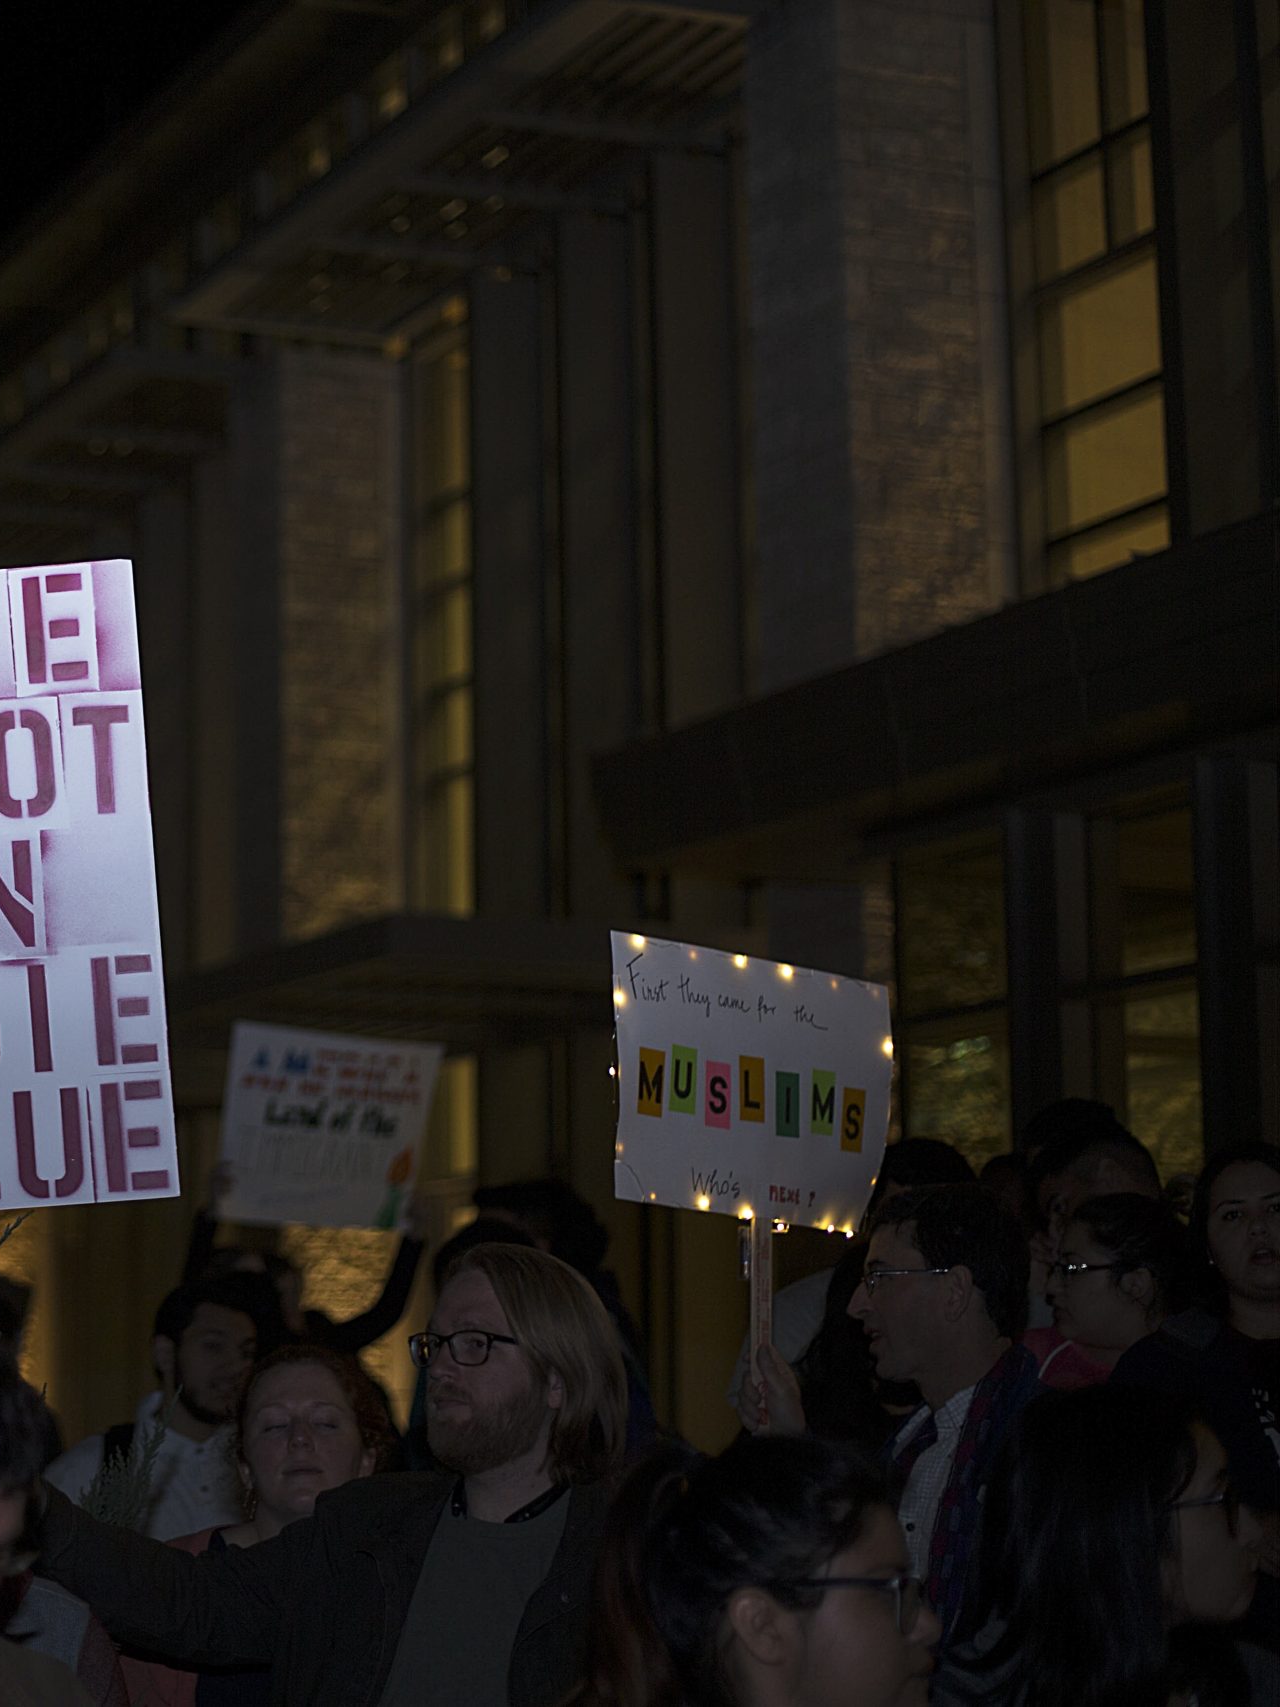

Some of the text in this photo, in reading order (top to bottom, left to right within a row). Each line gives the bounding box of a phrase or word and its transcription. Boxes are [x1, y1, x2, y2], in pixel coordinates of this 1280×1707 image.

[626, 953, 829, 1031] First they came for the
[637, 1057, 863, 1141] MUSLIMS
[691, 1167, 740, 1199] Who's
